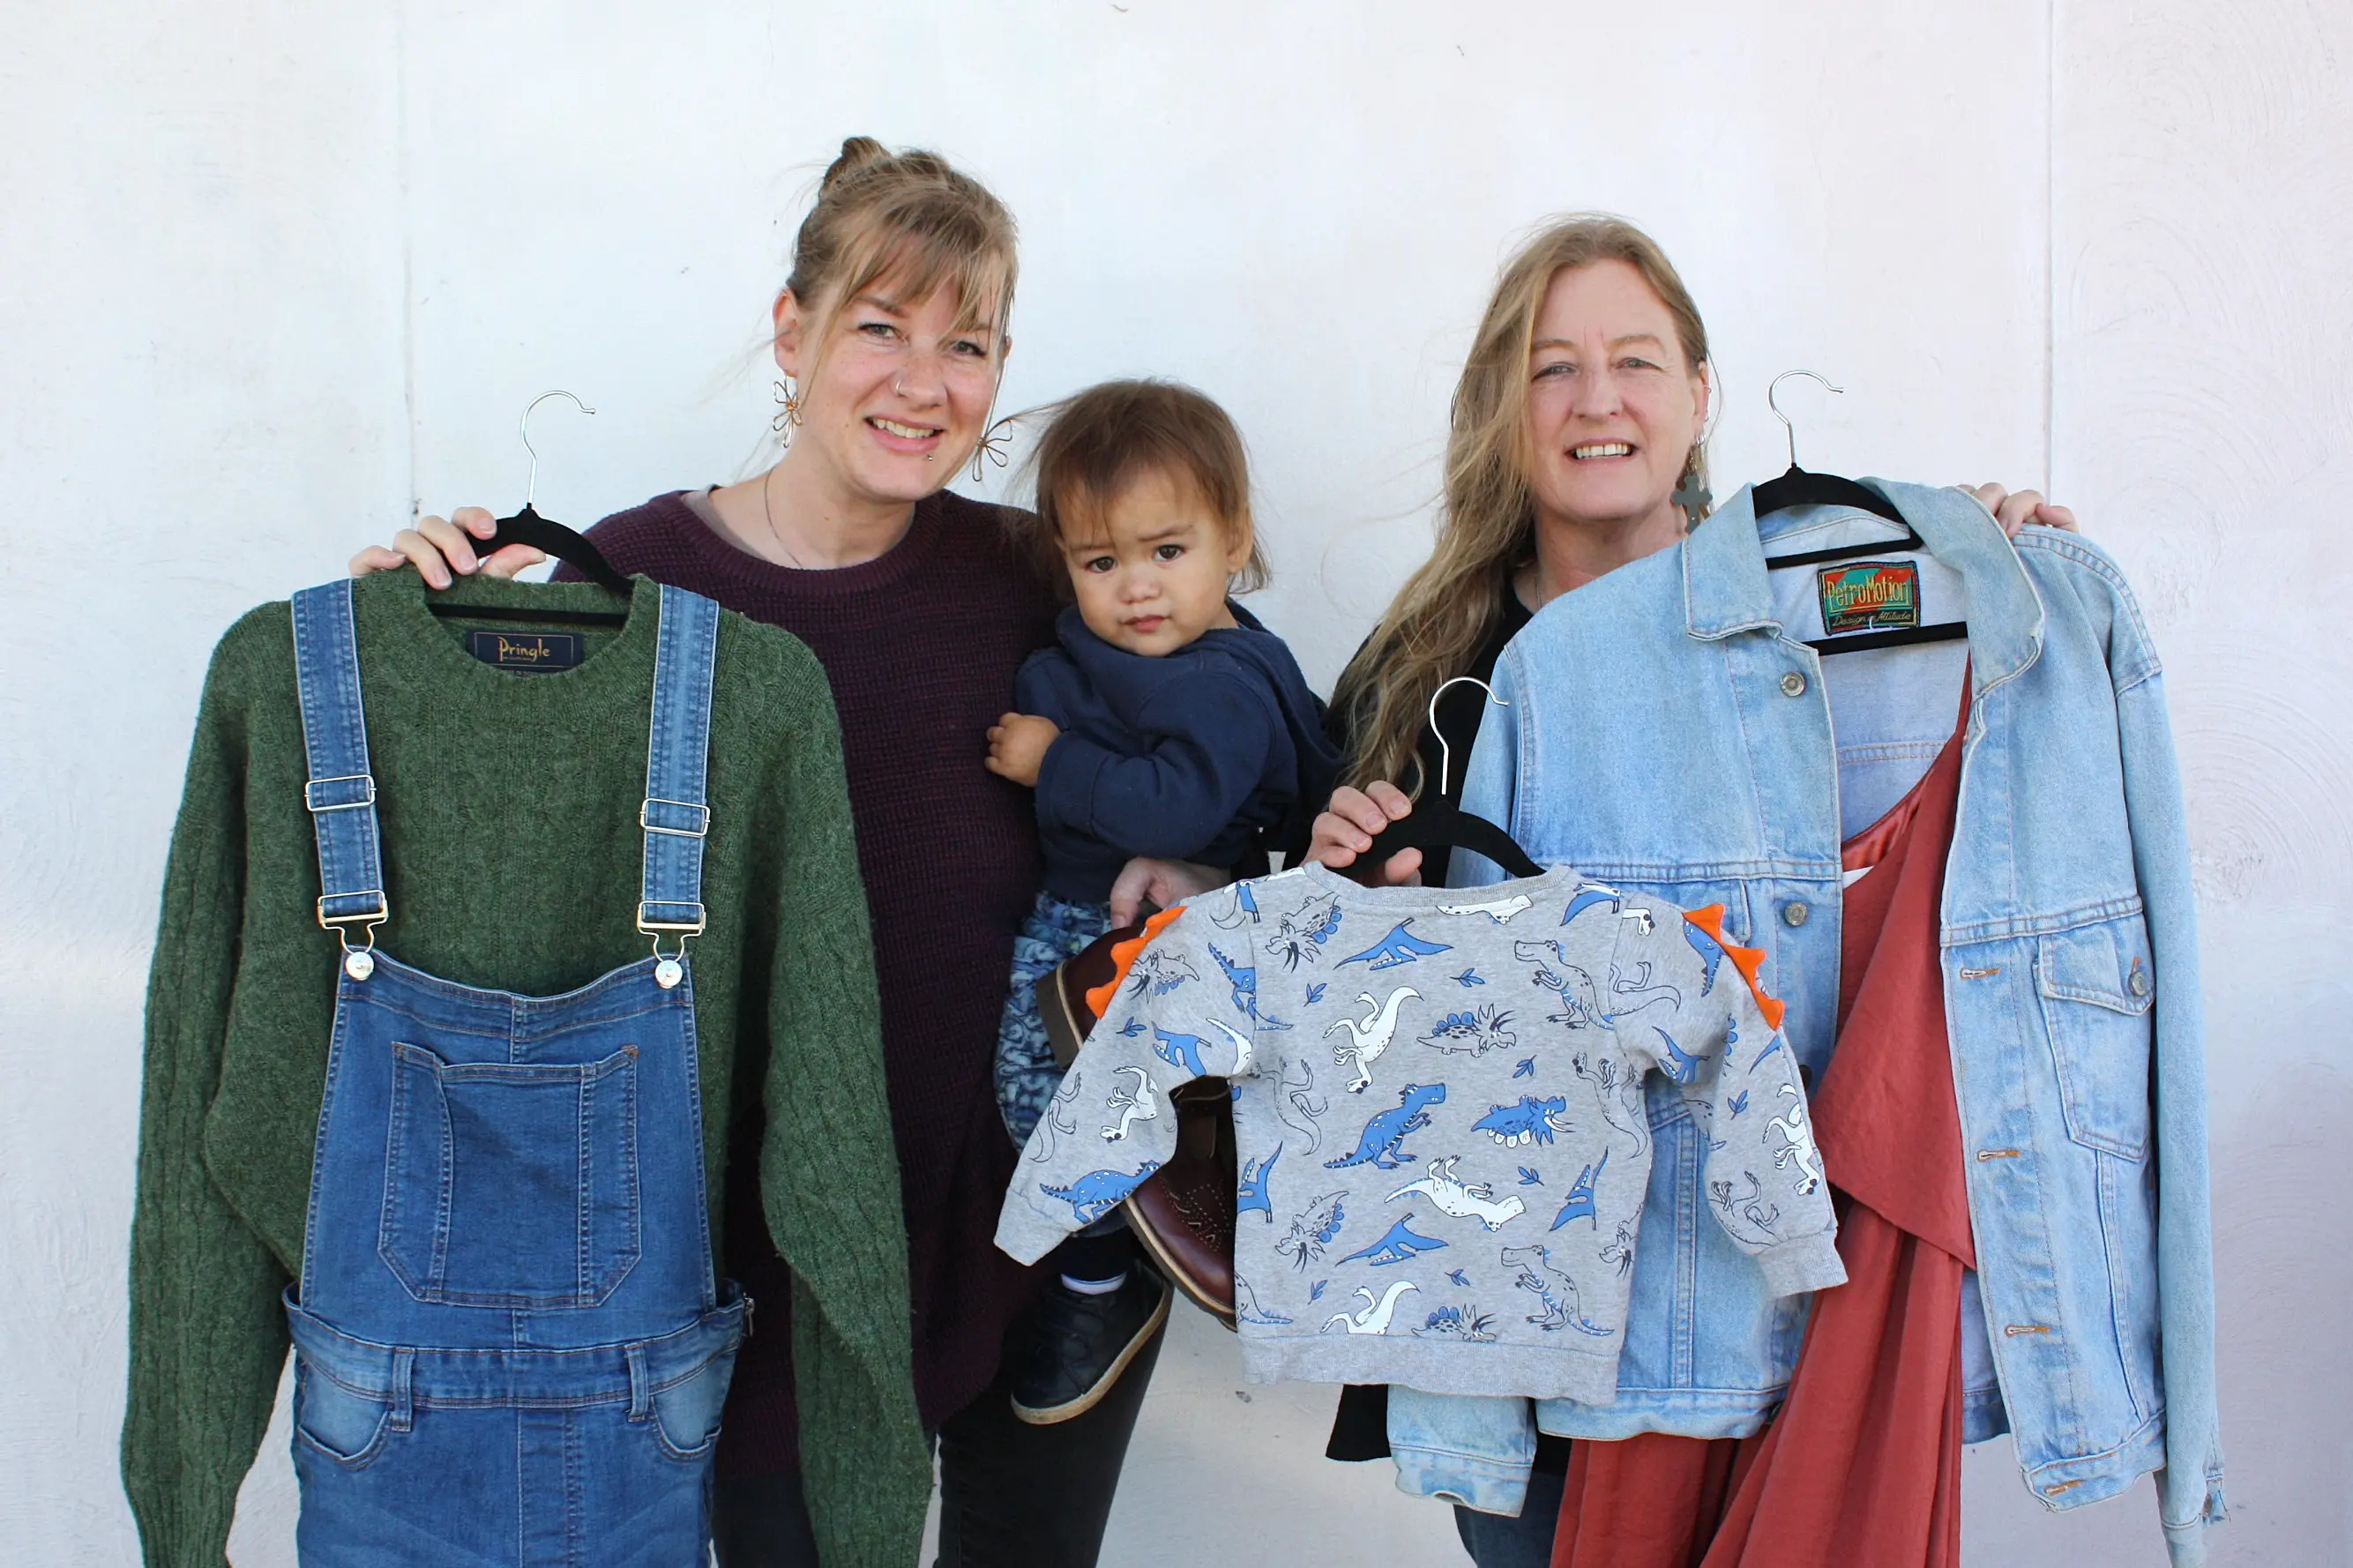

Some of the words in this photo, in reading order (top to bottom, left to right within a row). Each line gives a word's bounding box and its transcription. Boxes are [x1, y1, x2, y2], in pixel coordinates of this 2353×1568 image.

[1826, 575, 1909, 606] PetroMotion
[1832, 615, 1866, 627] Design
[1873, 610, 1911, 623] Attitude
[497, 636, 550, 661] Pringle
